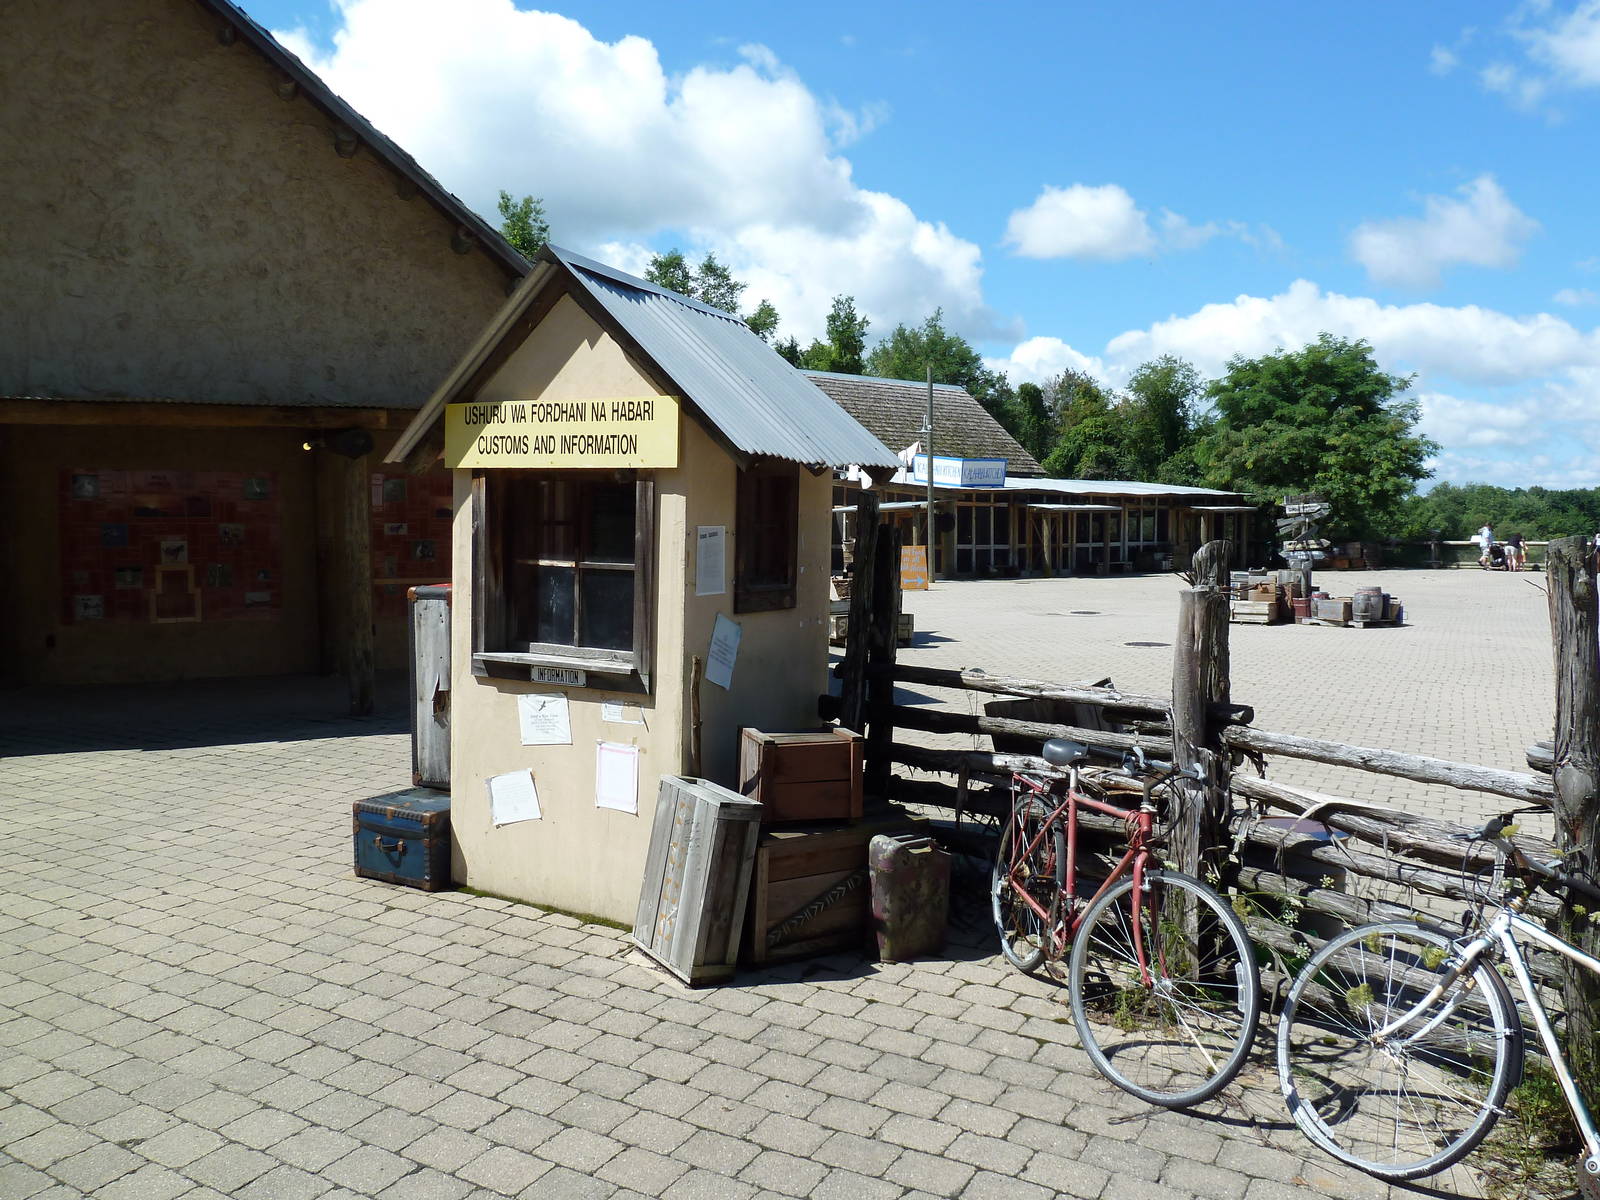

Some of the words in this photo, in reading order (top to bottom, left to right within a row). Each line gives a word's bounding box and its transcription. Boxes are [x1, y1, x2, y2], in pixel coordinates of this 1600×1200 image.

[464, 404, 507, 425] USHURU
[511, 403, 527, 424] WA
[531, 401, 587, 424] FORDHANI
[591, 401, 607, 422] NA
[611, 400, 654, 422] HABARI
[477, 435, 529, 455] CUSTOMS
[533, 435, 556, 455] AND
[560, 434, 638, 455] INFORMATION
[537, 667, 579, 684] INFORMATION
